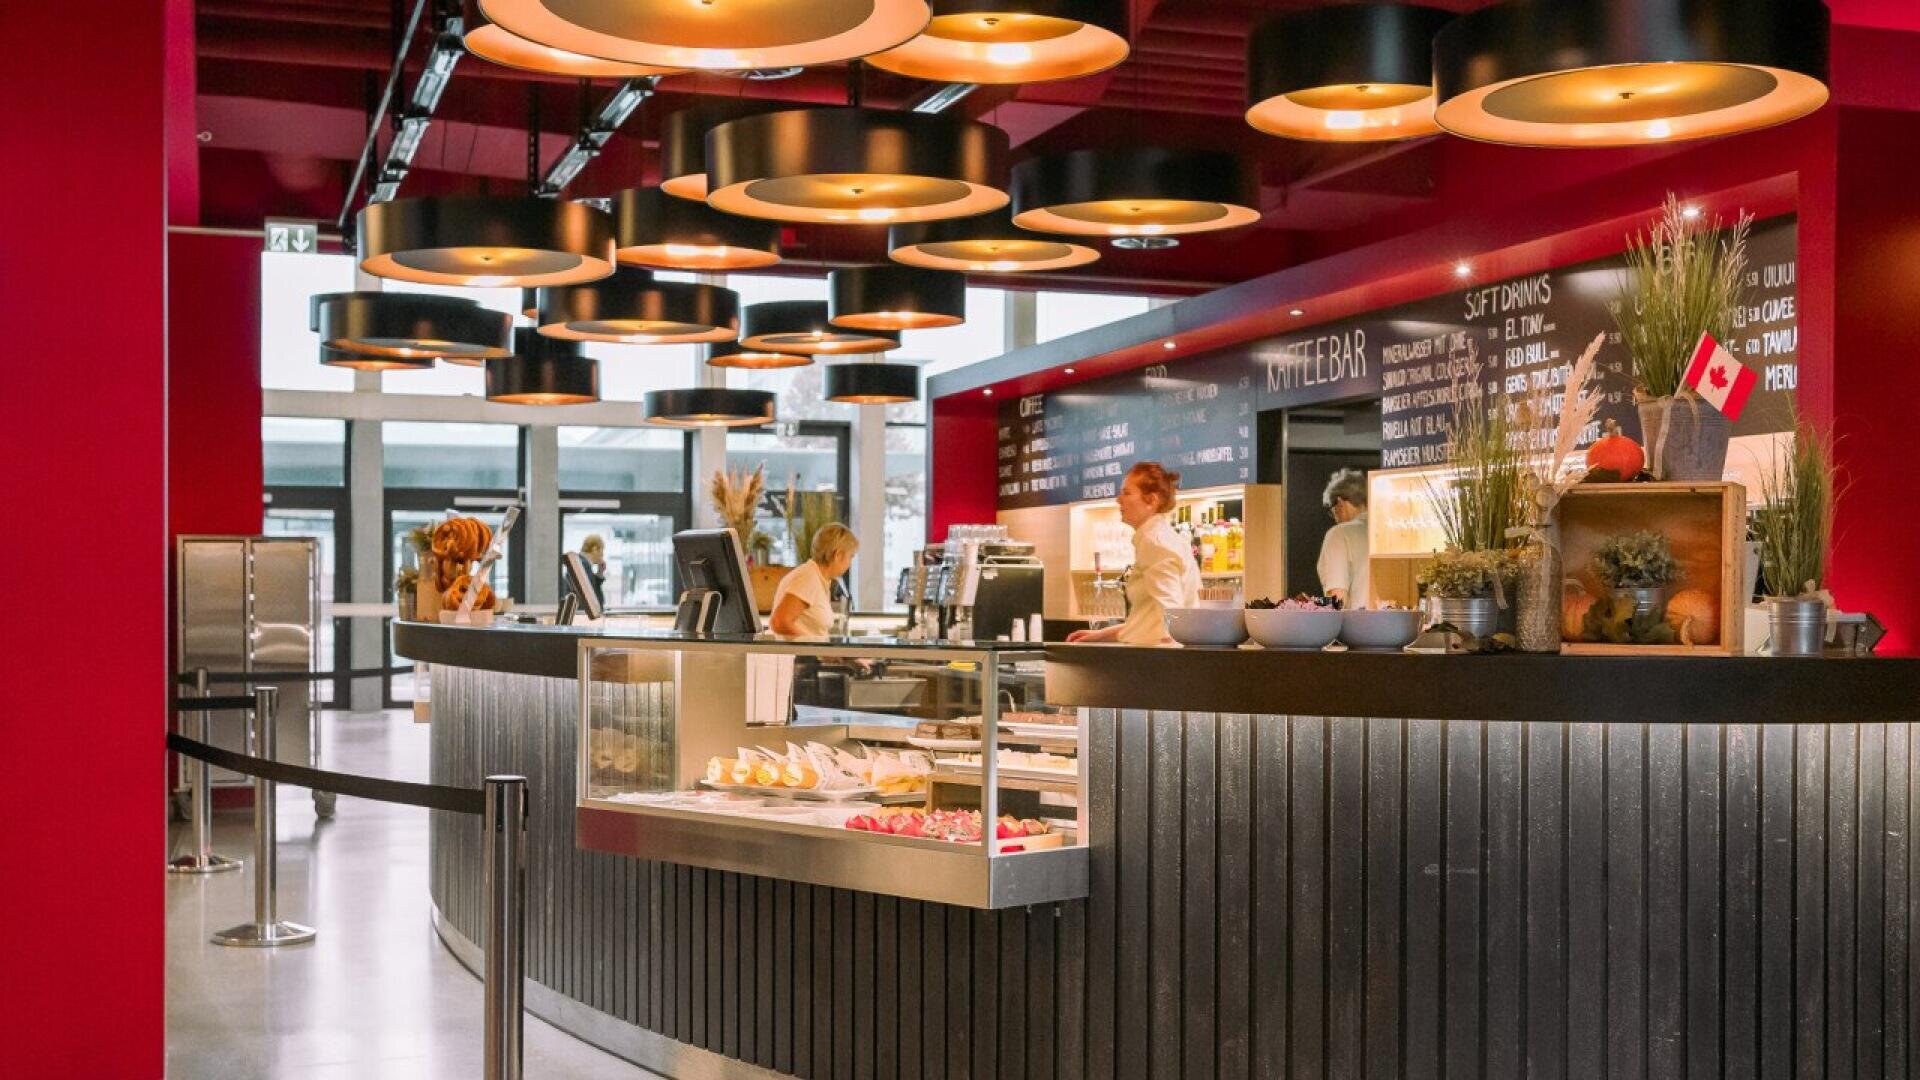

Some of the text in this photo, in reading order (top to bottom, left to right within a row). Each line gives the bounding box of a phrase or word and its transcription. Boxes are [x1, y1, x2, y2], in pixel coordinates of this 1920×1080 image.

[1464, 273, 1552, 321] SOFT DRINKS
[1506, 318, 1518, 341] EL
[1521, 313, 1544, 337] TONY
[1267, 329, 1366, 393] KAFFEEBAR
[1506, 347, 1525, 370] RED
[1527, 341, 1550, 365] BULL
